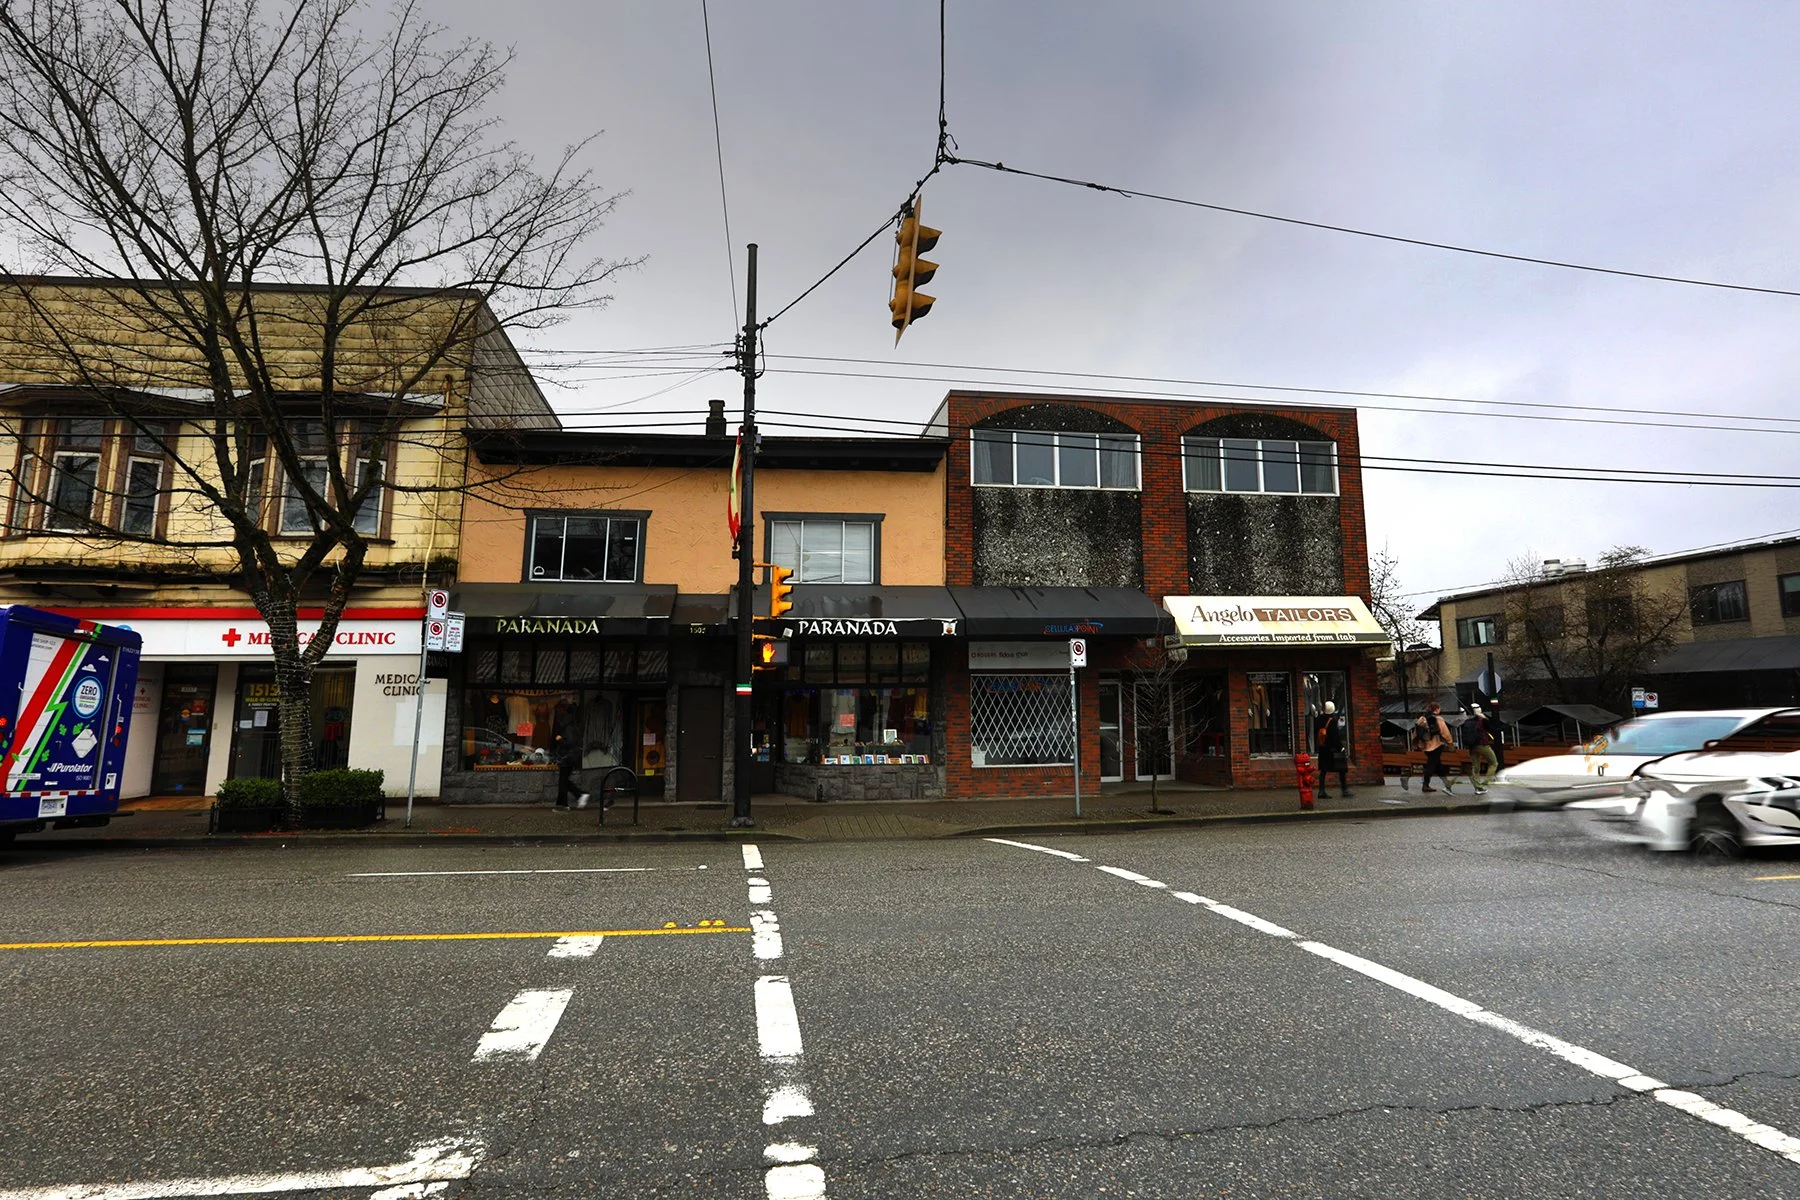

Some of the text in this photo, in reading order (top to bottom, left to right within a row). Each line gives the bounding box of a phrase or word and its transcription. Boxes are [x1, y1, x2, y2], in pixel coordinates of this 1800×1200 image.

[1191, 605, 1353, 626] Angelo TAILORS
[496, 617, 601, 635] PARANADA
[798, 620, 898, 636] PARANADA
[247, 632, 396, 645] MECA CLINIC
[1219, 634, 1357, 644] Accessories Imported from Italy
[81, 685, 98, 696] ZERO
[249, 683, 280, 697] 1515
[54, 762, 93, 773] Purolator
